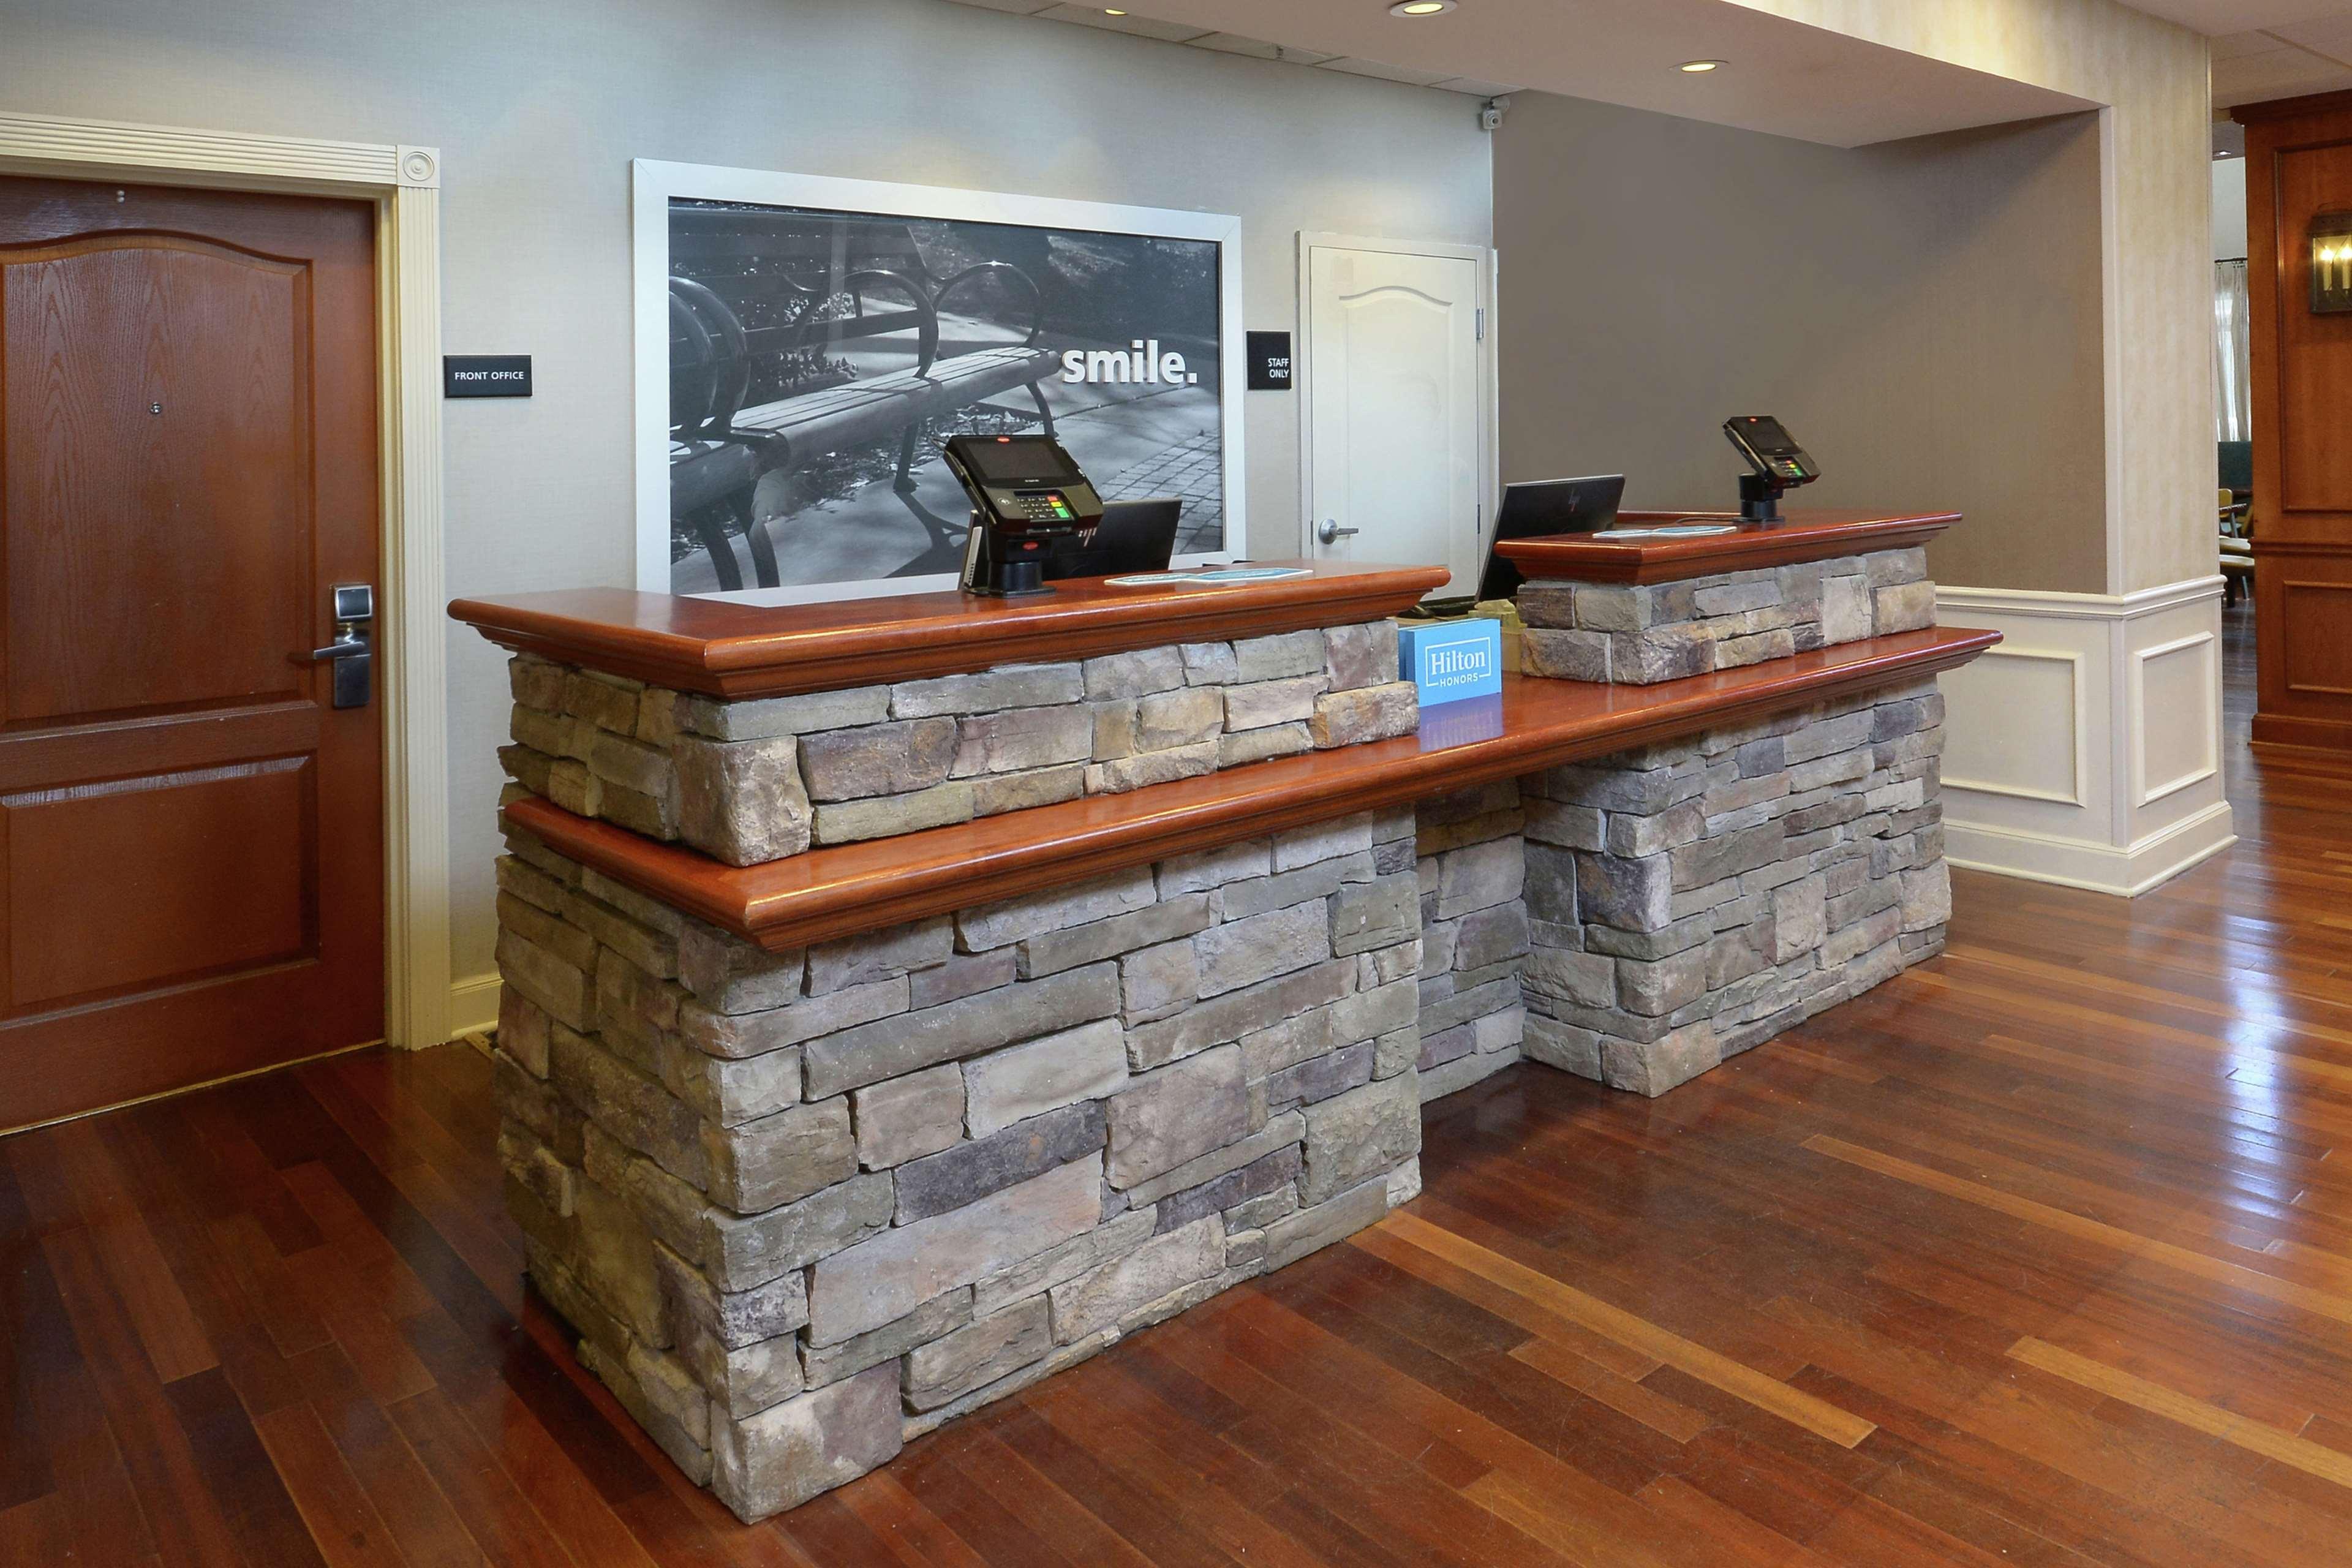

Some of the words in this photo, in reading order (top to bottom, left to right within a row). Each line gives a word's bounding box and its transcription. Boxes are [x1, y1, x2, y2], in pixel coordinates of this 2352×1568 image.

[1062, 339, 1197, 384] smile.
[1268, 358, 1289, 368] STAFF
[491, 371, 524, 380] OFFICE
[1269, 368, 1289, 378] ONLY
[1431, 650, 1485, 676] Hilton
[1440, 673, 1478, 687] HONORS
